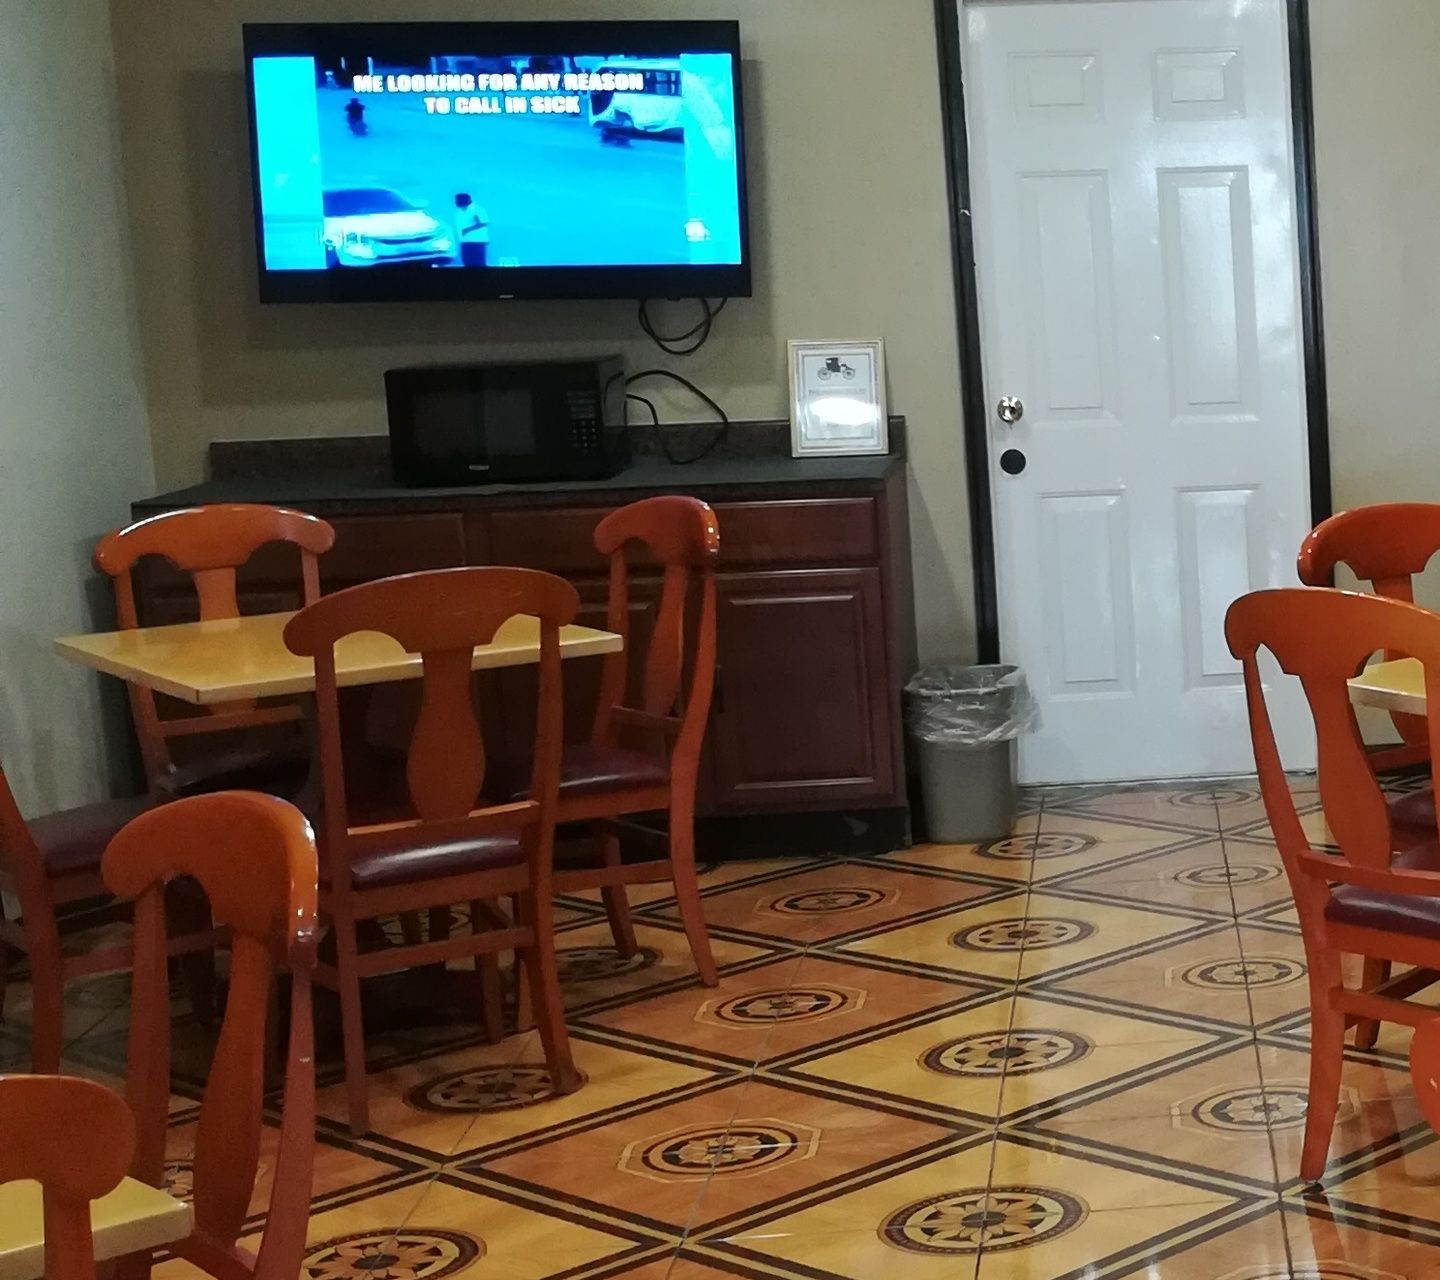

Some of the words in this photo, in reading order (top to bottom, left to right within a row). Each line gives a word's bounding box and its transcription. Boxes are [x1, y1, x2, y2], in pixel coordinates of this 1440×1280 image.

[353, 74, 384, 93] ME
[387, 74, 475, 92] LOOKING
[478, 73, 518, 91] FOR
[521, 73, 560, 91] ANY
[564, 72, 644, 91] REASON
[424, 97, 450, 114] TO
[454, 97, 501, 114] CALL
[505, 96, 527, 113] IN
[530, 96, 580, 113] SICK
